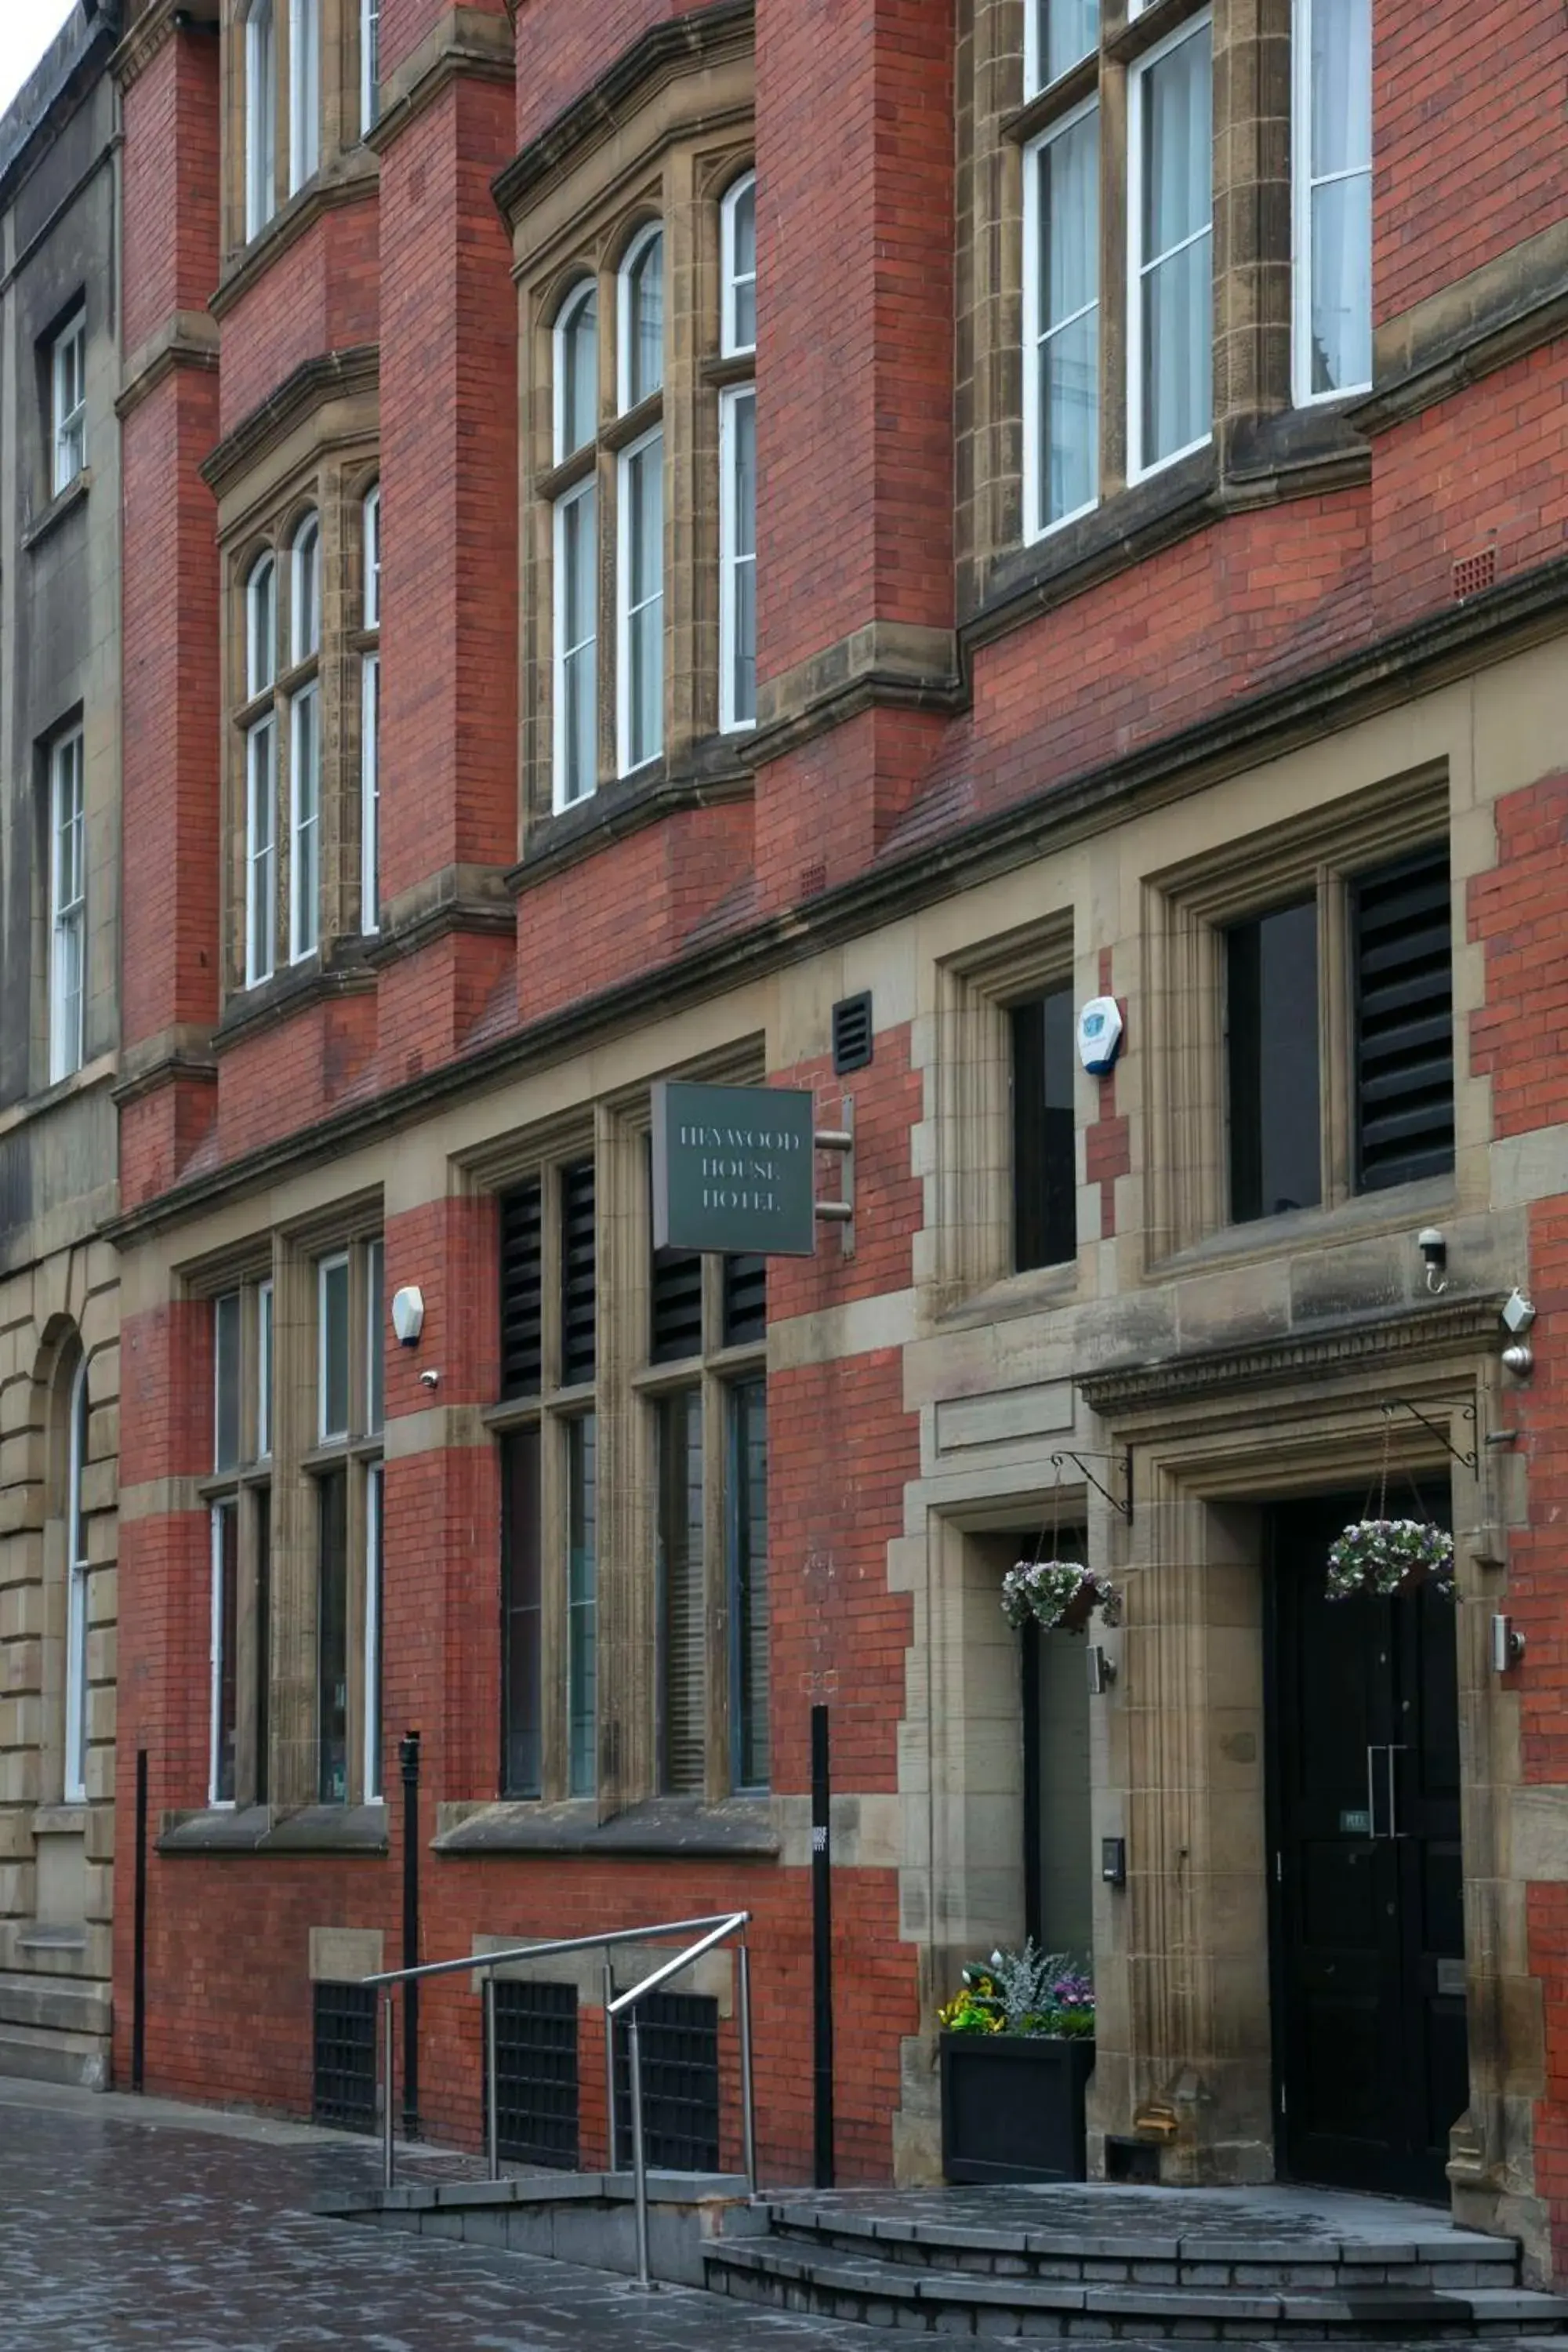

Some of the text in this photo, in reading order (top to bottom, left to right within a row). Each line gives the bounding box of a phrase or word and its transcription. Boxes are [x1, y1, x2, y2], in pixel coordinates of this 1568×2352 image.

[681, 1126, 800, 1151] HEYWOOD
[702, 1157, 782, 1181] HOUSE
[702, 1189, 782, 1212] HOTEL
